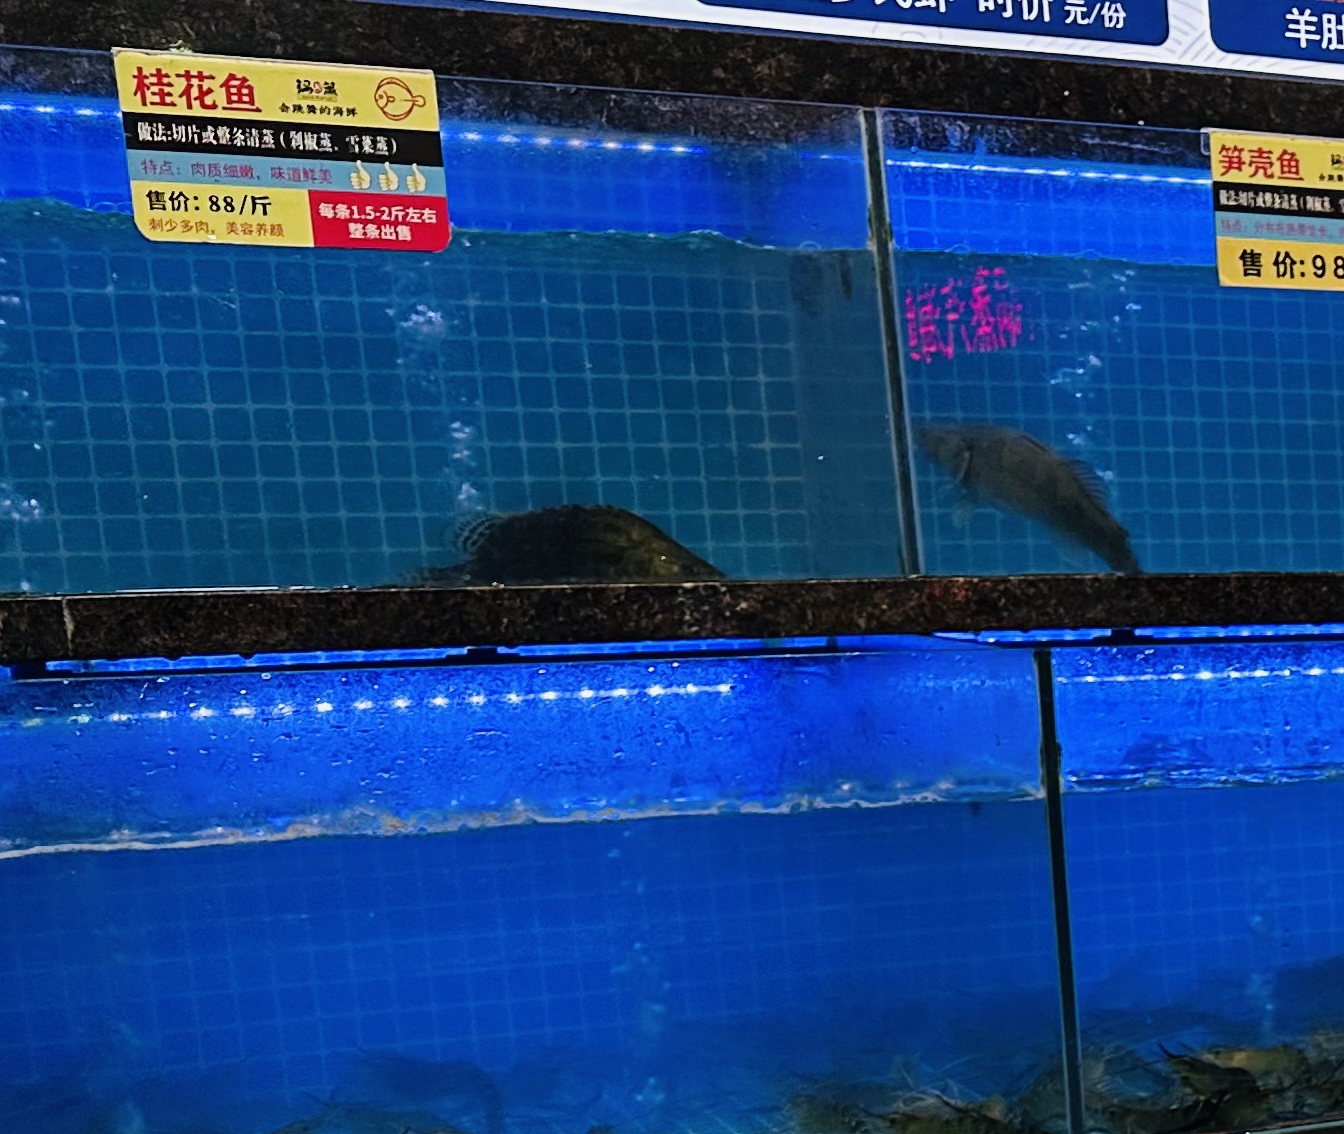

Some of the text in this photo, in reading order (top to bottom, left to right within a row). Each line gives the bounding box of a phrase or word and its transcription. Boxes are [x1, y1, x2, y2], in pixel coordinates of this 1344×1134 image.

[132, 65, 263, 114] 桂花鱼
[1218, 143, 1304, 182] 笋壳鱼
[318, 202, 437, 224] 每条1.5-2斤左右
[348, 223, 413, 242] 整条出售
